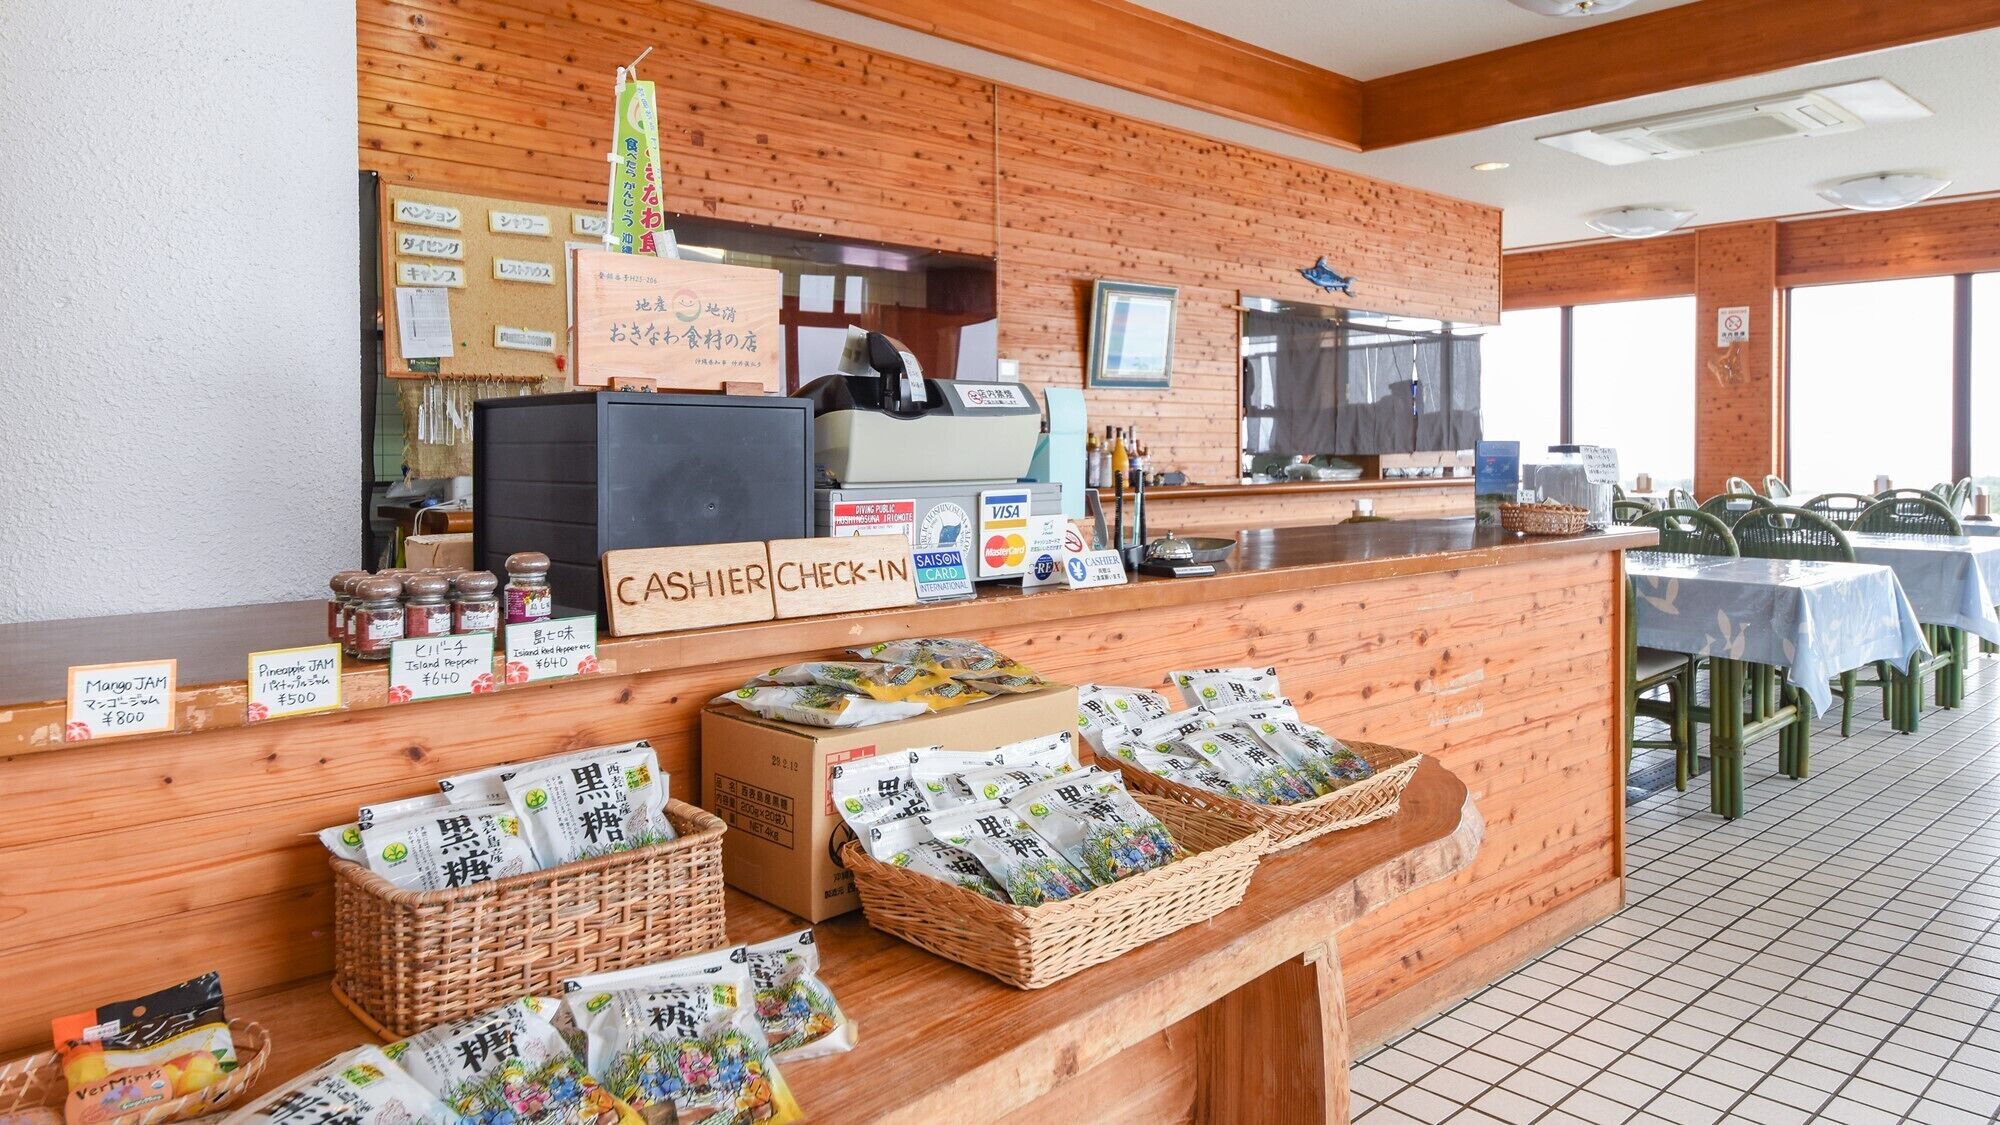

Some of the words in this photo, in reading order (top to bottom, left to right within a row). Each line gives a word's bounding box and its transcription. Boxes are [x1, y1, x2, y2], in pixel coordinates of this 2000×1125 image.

[625, 137, 638, 178] 食べたら
[622, 181, 635, 227] がんじゅう
[401, 205, 457, 223] ペンション
[500, 215, 544, 229] シャワー
[403, 237, 459, 255] ダイビング
[499, 263, 550, 278] レストハウス
[634, 295, 668, 312] 地産
[705, 302, 738, 323] 地消
[609, 321, 758, 353] おきなわ食材の店
[977, 388, 1015, 400] 店内禁煙
[855, 504, 875, 515] DIVING
[875, 503, 896, 513] PUBLIC
[992, 505, 1020, 519] VISA
[985, 545, 1026, 558] MasterCard
[916, 552, 961, 568] SAISON
[1085, 555, 1121, 567] CASHIER
[617, 563, 767, 606] CASHIER
[776, 557, 908, 593] CHECK-IN
[925, 566, 959, 581] CARD
[919, 580, 970, 594] INTERNATIONAL
[533, 625, 575, 646] 島七味
[415, 639, 468, 658] ヒバーチ
[513, 648, 539, 658] Island
[259, 660, 306, 678] Pineapple
[308, 658, 334, 672] JAM
[405, 658, 440, 671] Island
[444, 657, 479, 669] Pepper
[535, 656, 568, 670] ¥640
[86, 679, 133, 694] Mango
[134, 676, 167, 690] JAM
[262, 674, 330, 694] パイナップルジャム
[422, 671, 460, 687] ¥640
[83, 694, 160, 710] マンゴージャム
[278, 691, 316, 706] ¥500
[102, 710, 145, 727] ¥800
[571, 762, 625, 844] 黒糖
[749, 819, 764, 834] NET
[765, 826, 779, 841] 4kg
[436, 814, 494, 888] 黒糖
